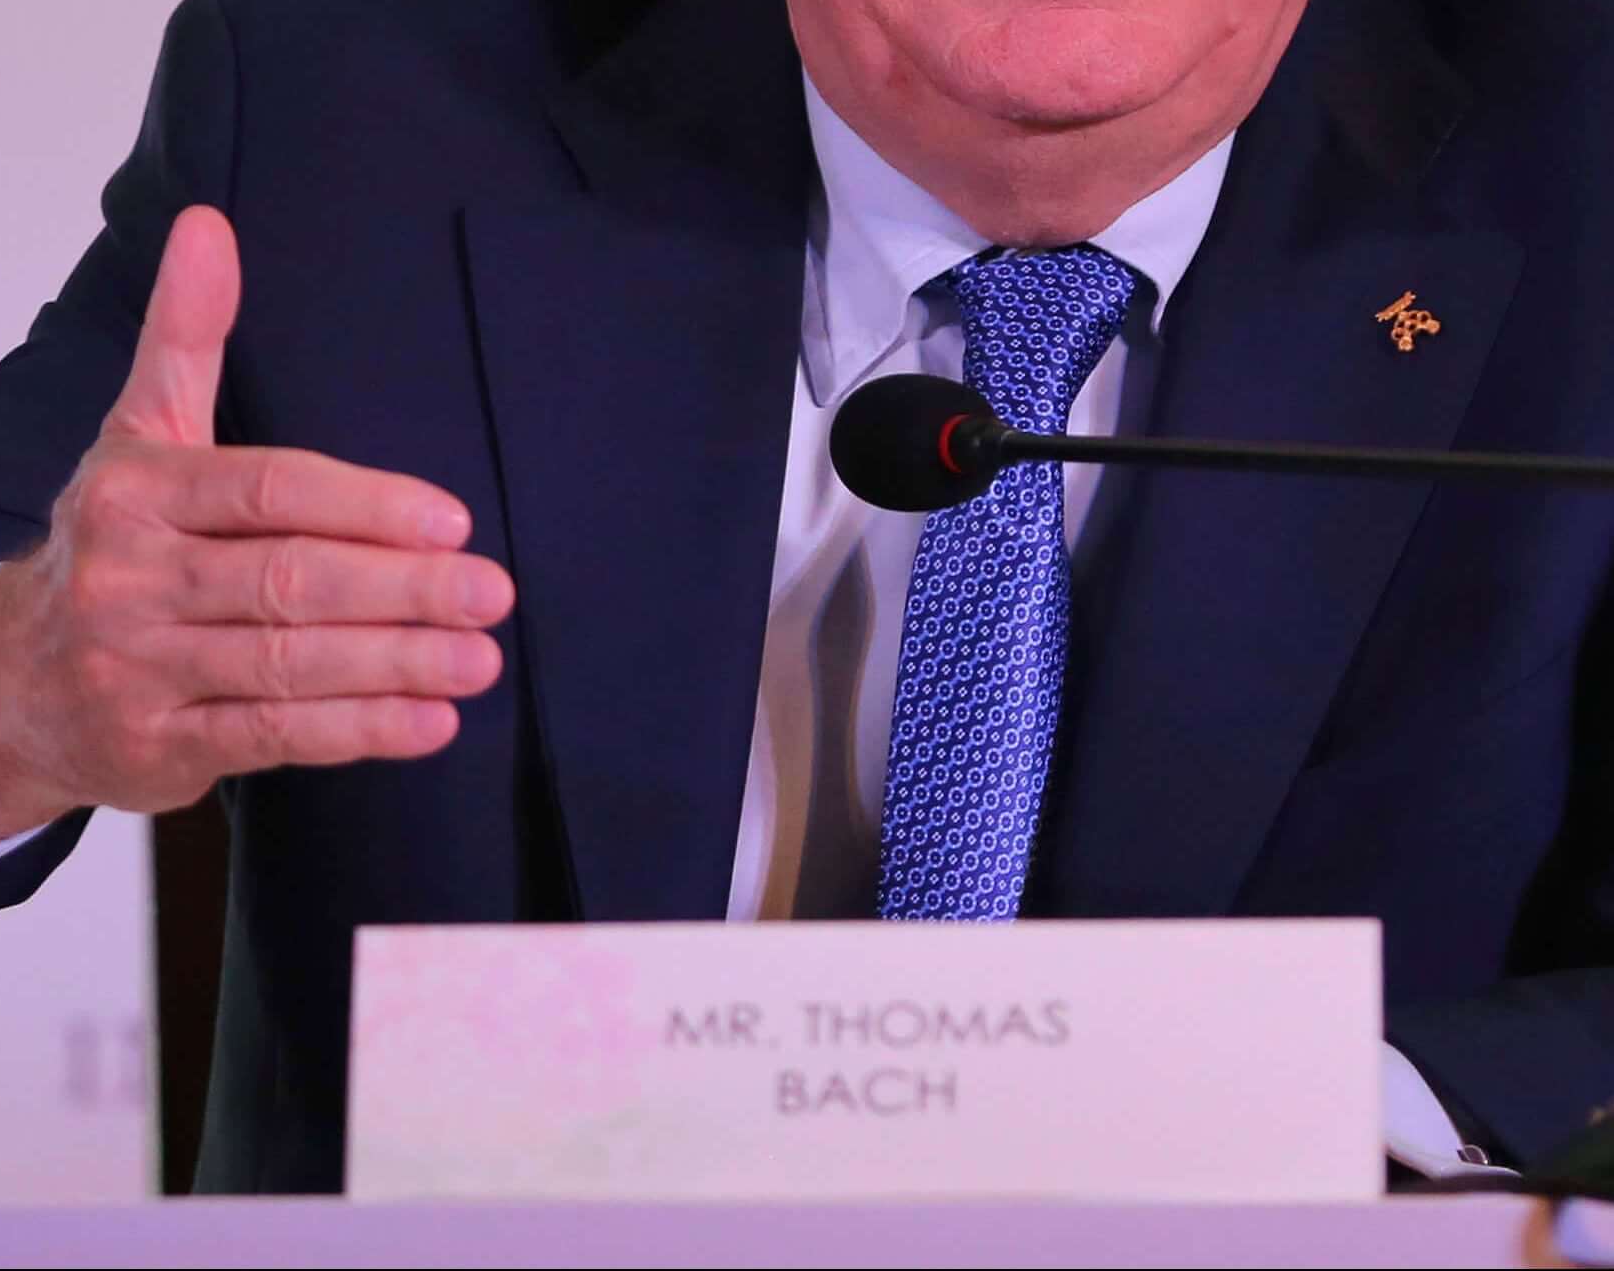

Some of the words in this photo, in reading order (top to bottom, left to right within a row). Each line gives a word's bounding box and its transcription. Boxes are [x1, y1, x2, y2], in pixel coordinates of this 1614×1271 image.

[664, 1001, 780, 1049] MR.
[801, 998, 1073, 1050] THOMAS
[775, 1065, 960, 1118] BACH
